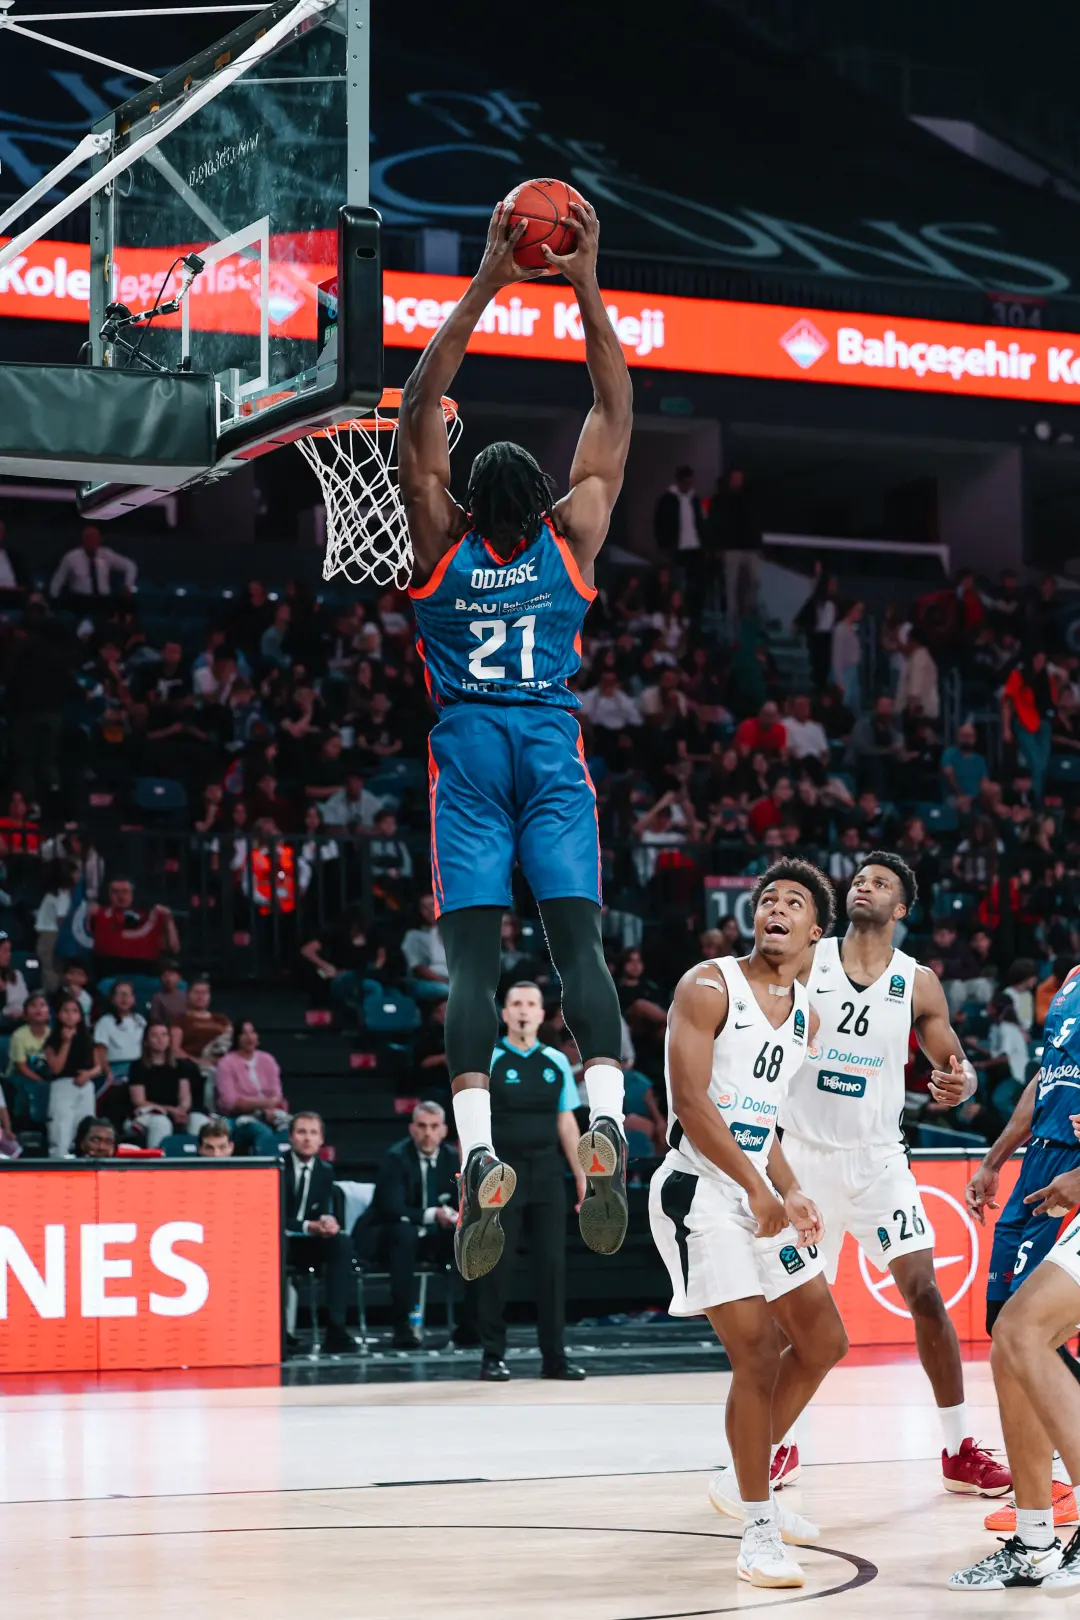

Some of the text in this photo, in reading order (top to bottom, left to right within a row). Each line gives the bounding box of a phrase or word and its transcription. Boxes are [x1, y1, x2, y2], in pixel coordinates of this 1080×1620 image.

[553, 301, 664, 356] Kleji
[837, 328, 1036, 380] Bahçeşehir
[471, 557, 538, 589] ODIASE
[455, 598, 497, 614] BAU
[469, 615, 536, 680] 21
[837, 1001, 870, 1037] 26
[1052, 1017, 1077, 1048] 5
[753, 1041, 784, 1083] 68
[827, 1048, 885, 1068] Dolomiti
[893, 1205, 925, 1240] 26
[0, 1220, 210, 1320] NES
[1014, 1240, 1034, 1275] 5
